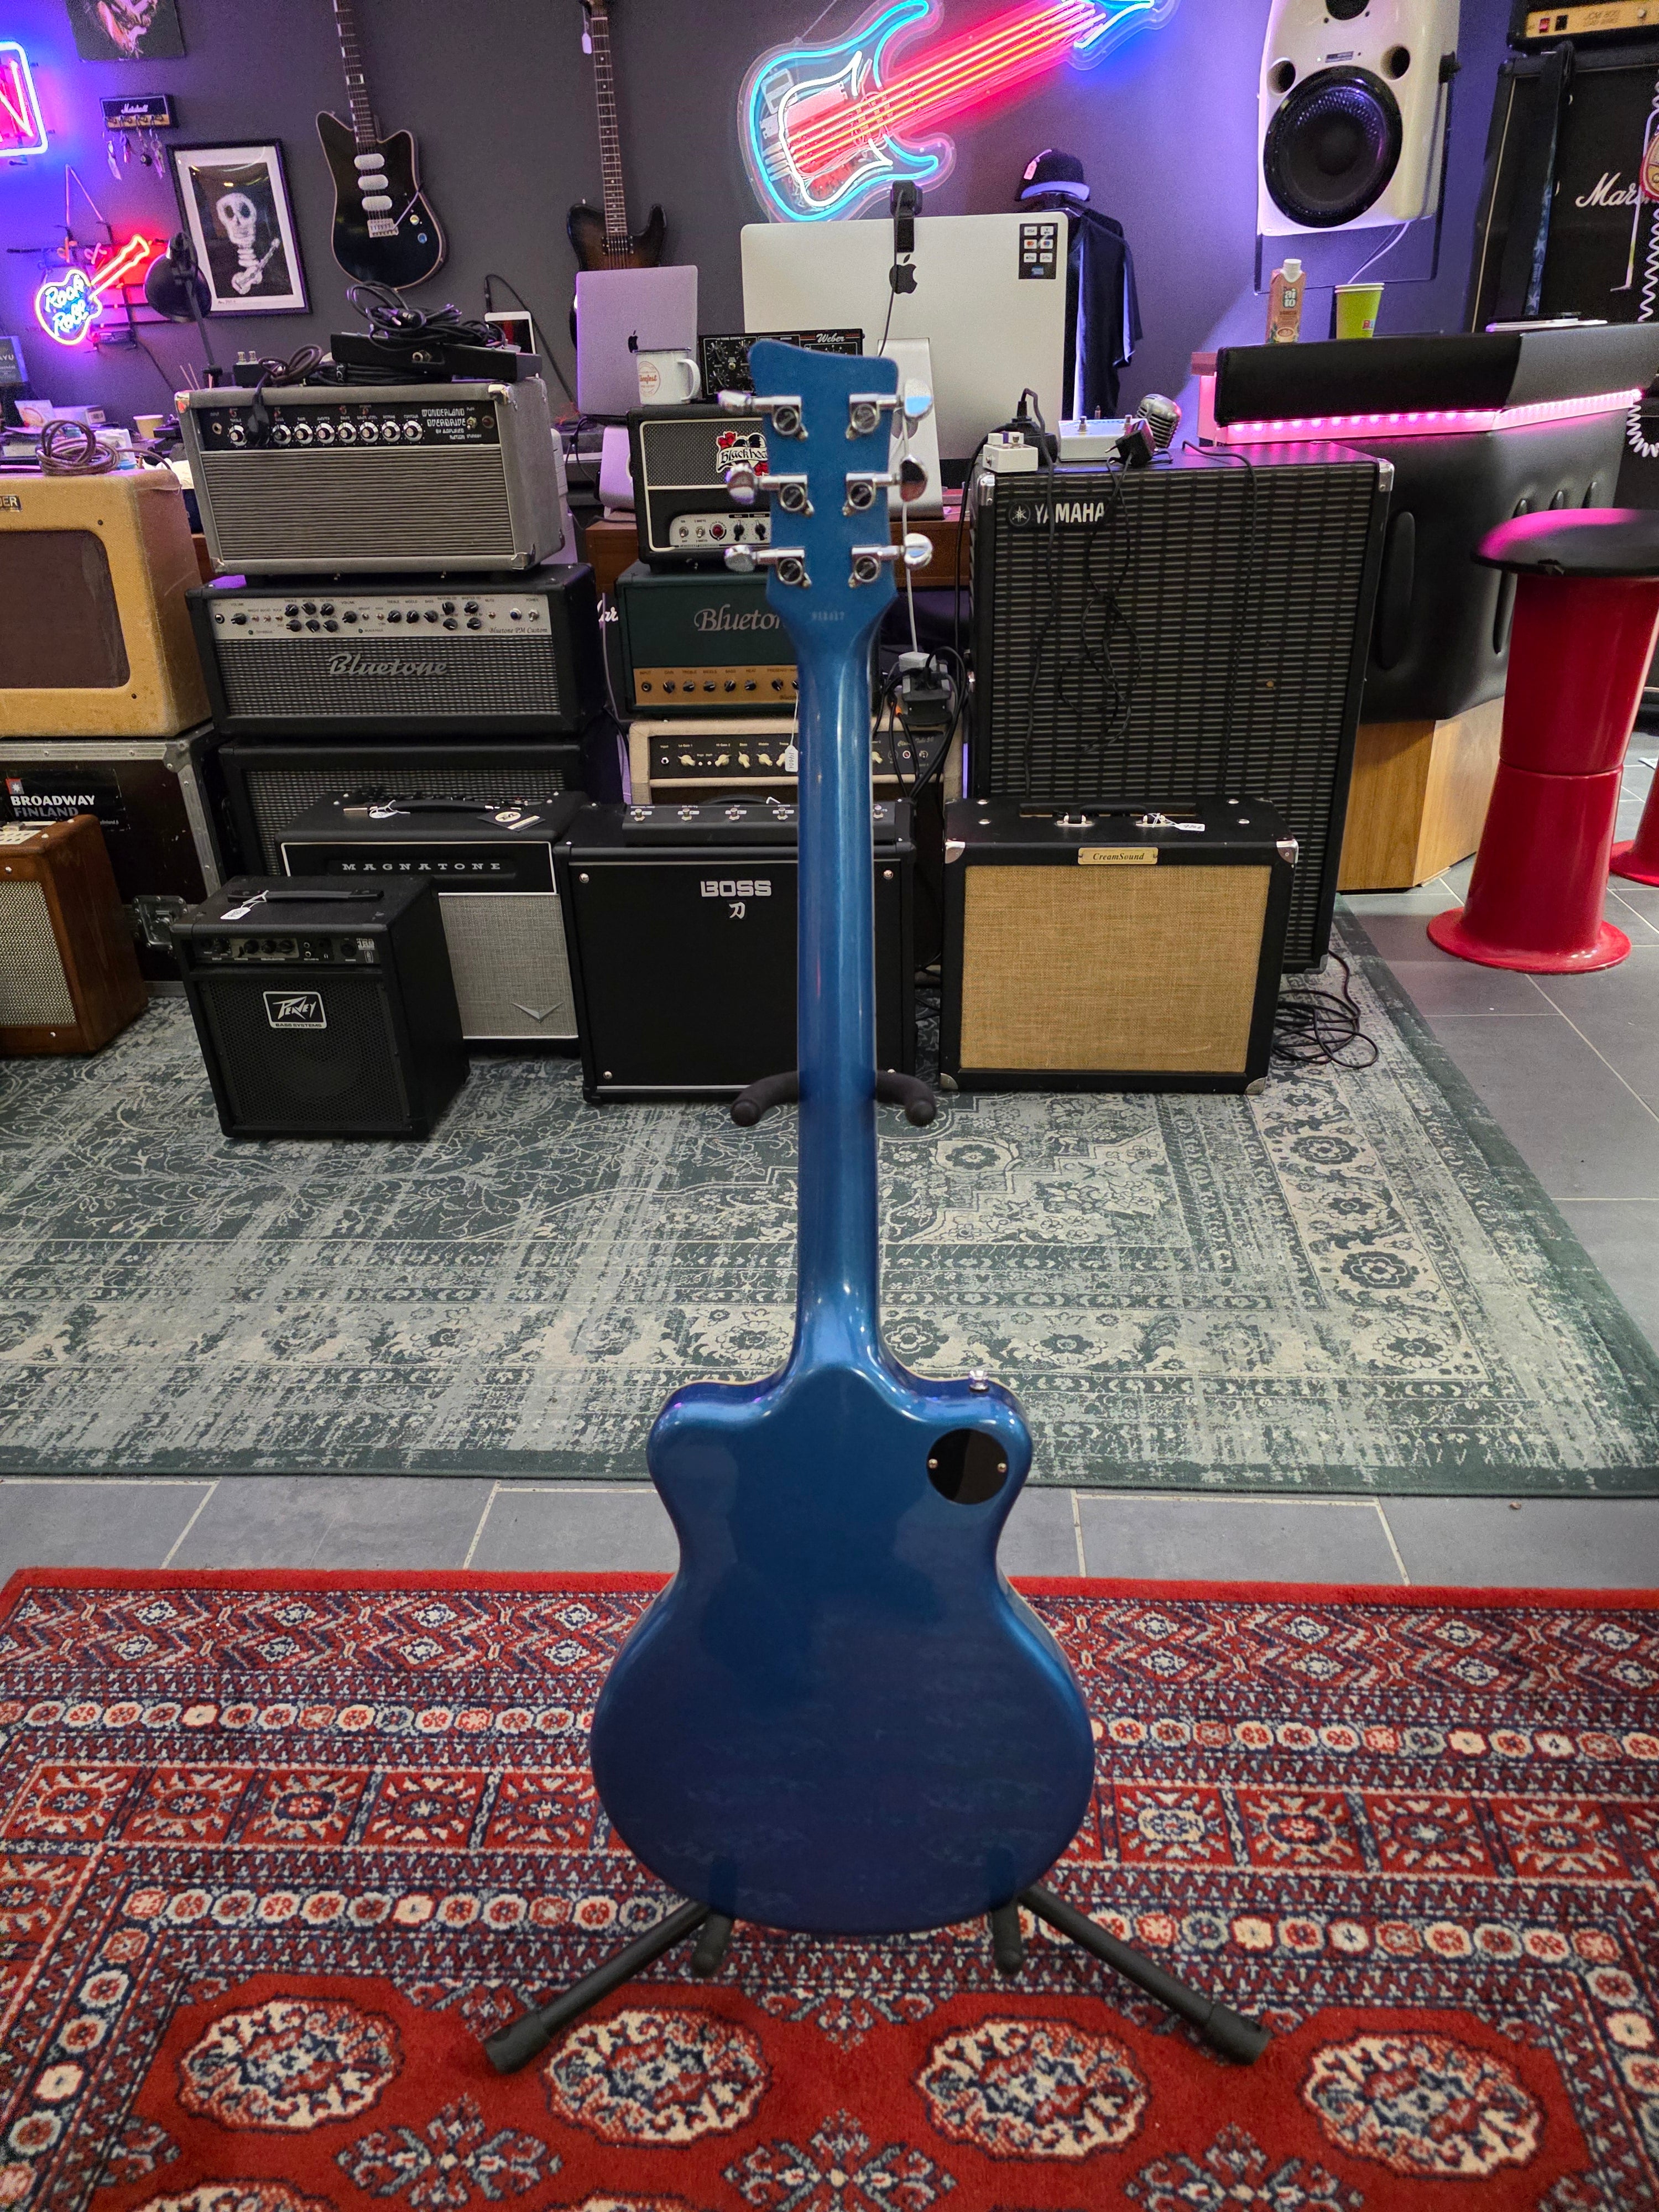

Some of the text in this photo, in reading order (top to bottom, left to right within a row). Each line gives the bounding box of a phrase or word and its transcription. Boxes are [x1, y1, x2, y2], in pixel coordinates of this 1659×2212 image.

[816, 333, 846, 343] Weber
[421, 408, 465, 418] WONDERLAND
[427, 418, 466, 427] OVERDRIVE
[328, 653, 447, 676] Bluetone
[10, 795, 95, 806] BROADWAY
[14, 807, 79, 817] FINLAND
[700, 880, 772, 898] BOSS
